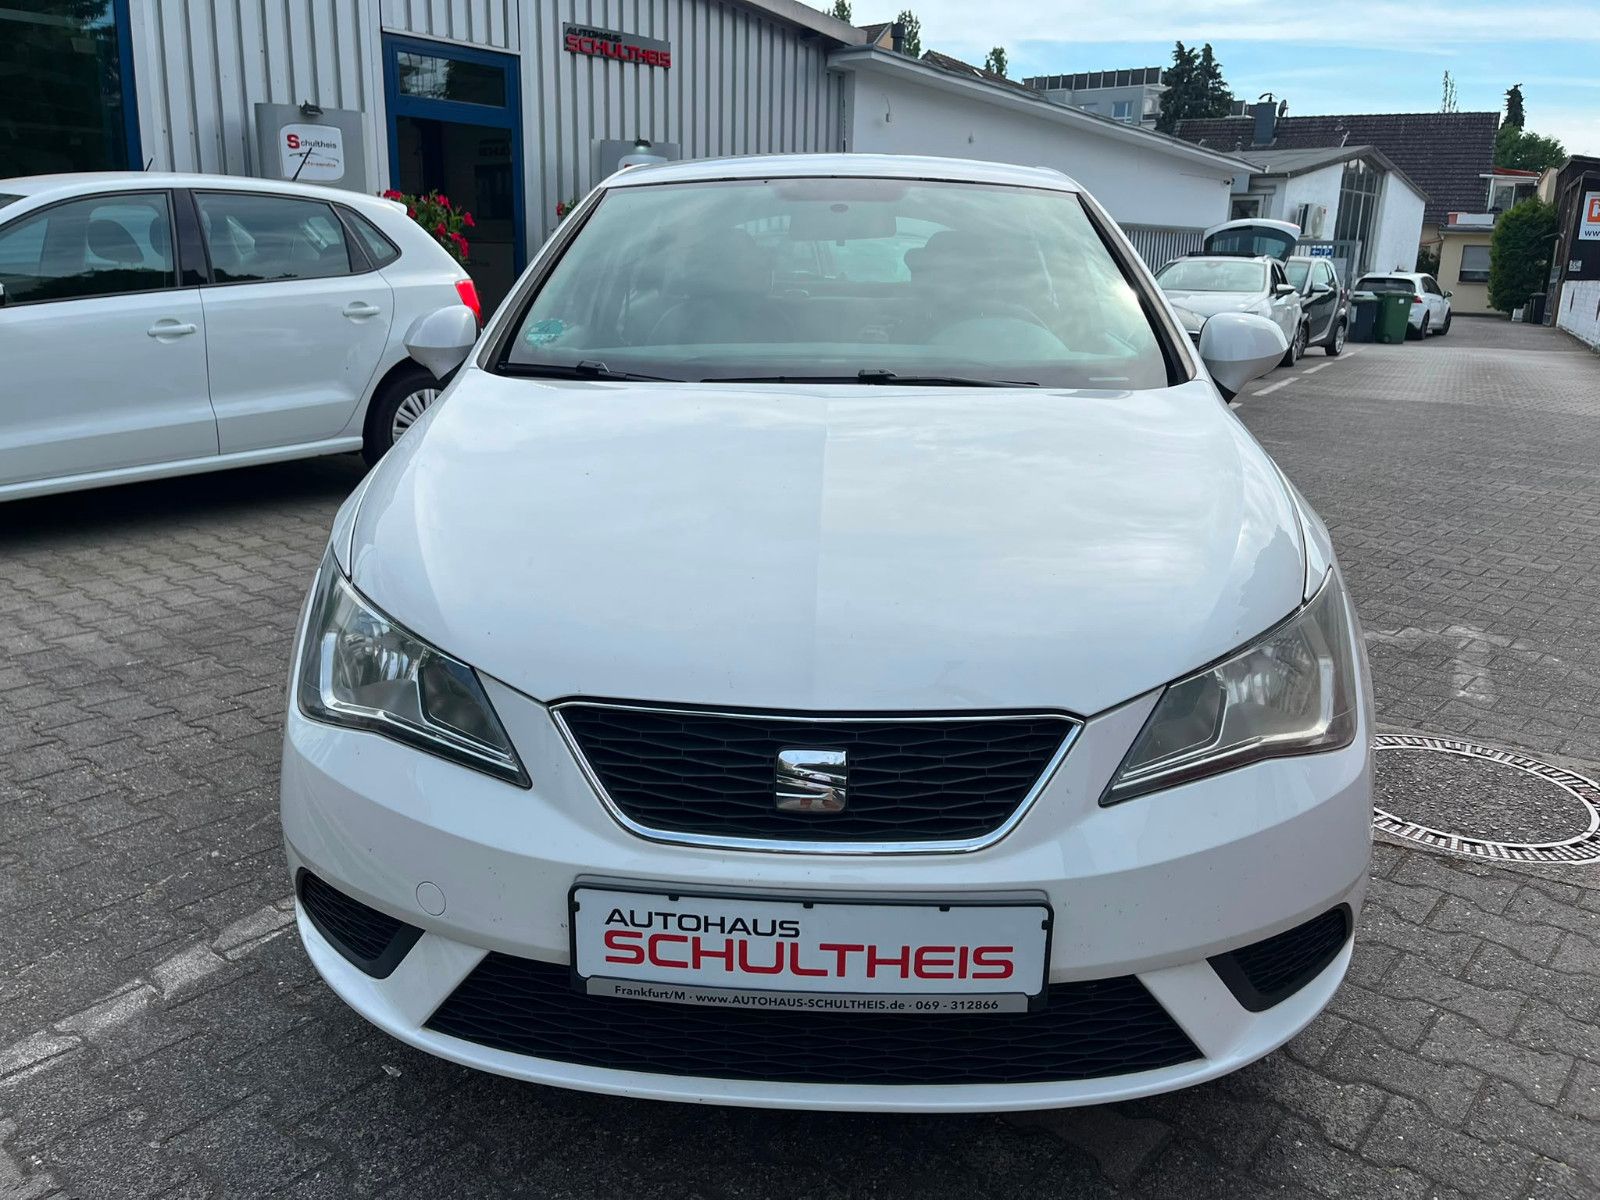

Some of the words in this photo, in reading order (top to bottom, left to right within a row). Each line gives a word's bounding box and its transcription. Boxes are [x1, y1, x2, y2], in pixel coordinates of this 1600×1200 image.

[566, 27, 622, 42] AUTOHAUS
[566, 34, 671, 68] SCHULTHEIS
[286, 134, 337, 149] Schultheis
[604, 908, 801, 938] AUTOHAUS
[604, 929, 1014, 979] SCHULTHEIS
[614, 985, 686, 1001] Frankfurt/M
[695, 994, 905, 1010] www.AUTOHAUS-SCHULTHEIS.de
[915, 1001, 939, 1010] 069
[950, 1001, 999, 1010] 312866
